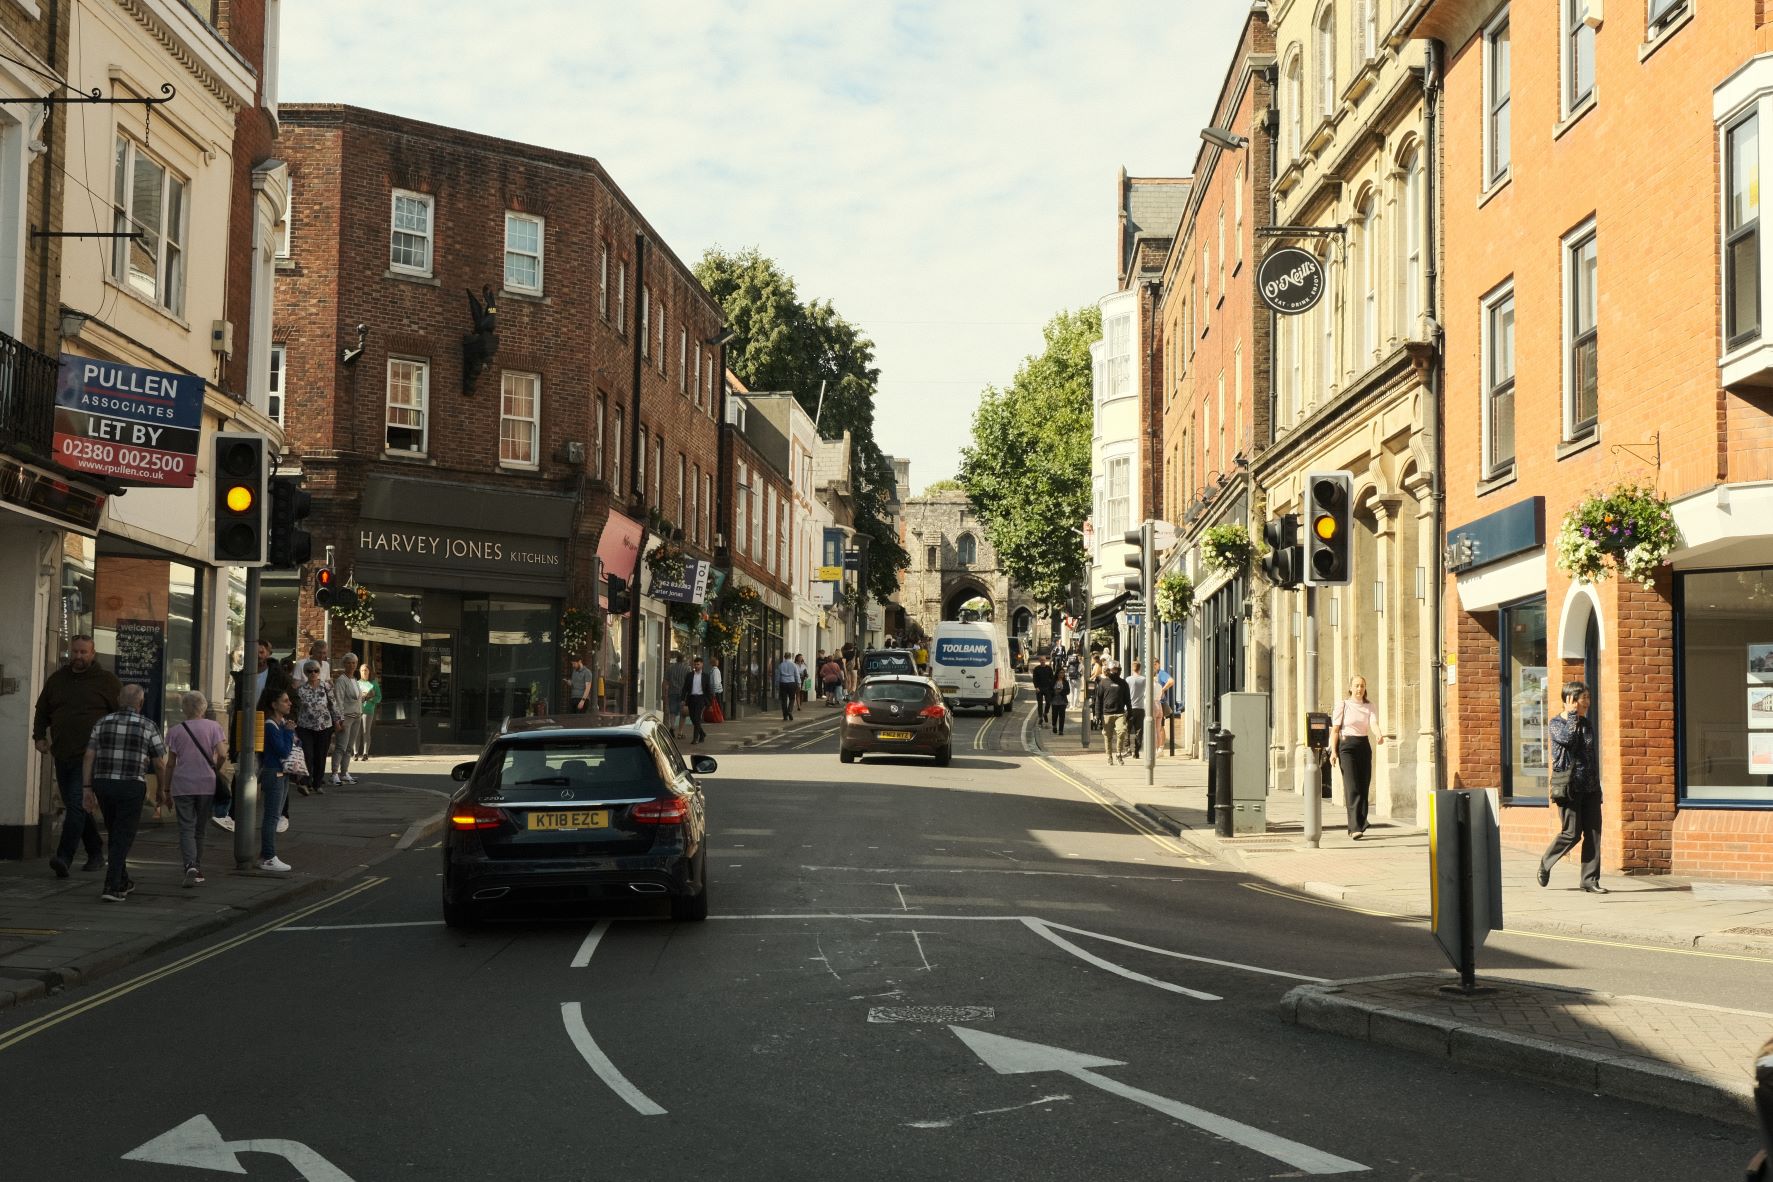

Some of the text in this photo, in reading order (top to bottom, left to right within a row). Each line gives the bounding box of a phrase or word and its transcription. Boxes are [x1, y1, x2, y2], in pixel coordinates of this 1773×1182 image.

[1265, 261, 1316, 297] O'Neill's
[1275, 298, 1286, 306] EAT
[1291, 298, 1310, 307] DRINK
[83, 364, 178, 399] PULLEN
[81, 394, 175, 418] ASSOCIATES
[88, 417, 163, 446] LET BY
[63, 438, 184, 472] 02380 002500
[78, 459, 164, 480] www.rpullen.co.uk
[360, 530, 559, 565] HARVEY JONES KITCHENS
[696, 564, 706, 598] TO LET
[121, 623, 160, 633] welcome
[942, 644, 987, 654] TOOLBANK
[537, 813, 599, 827] KT18 EZC
